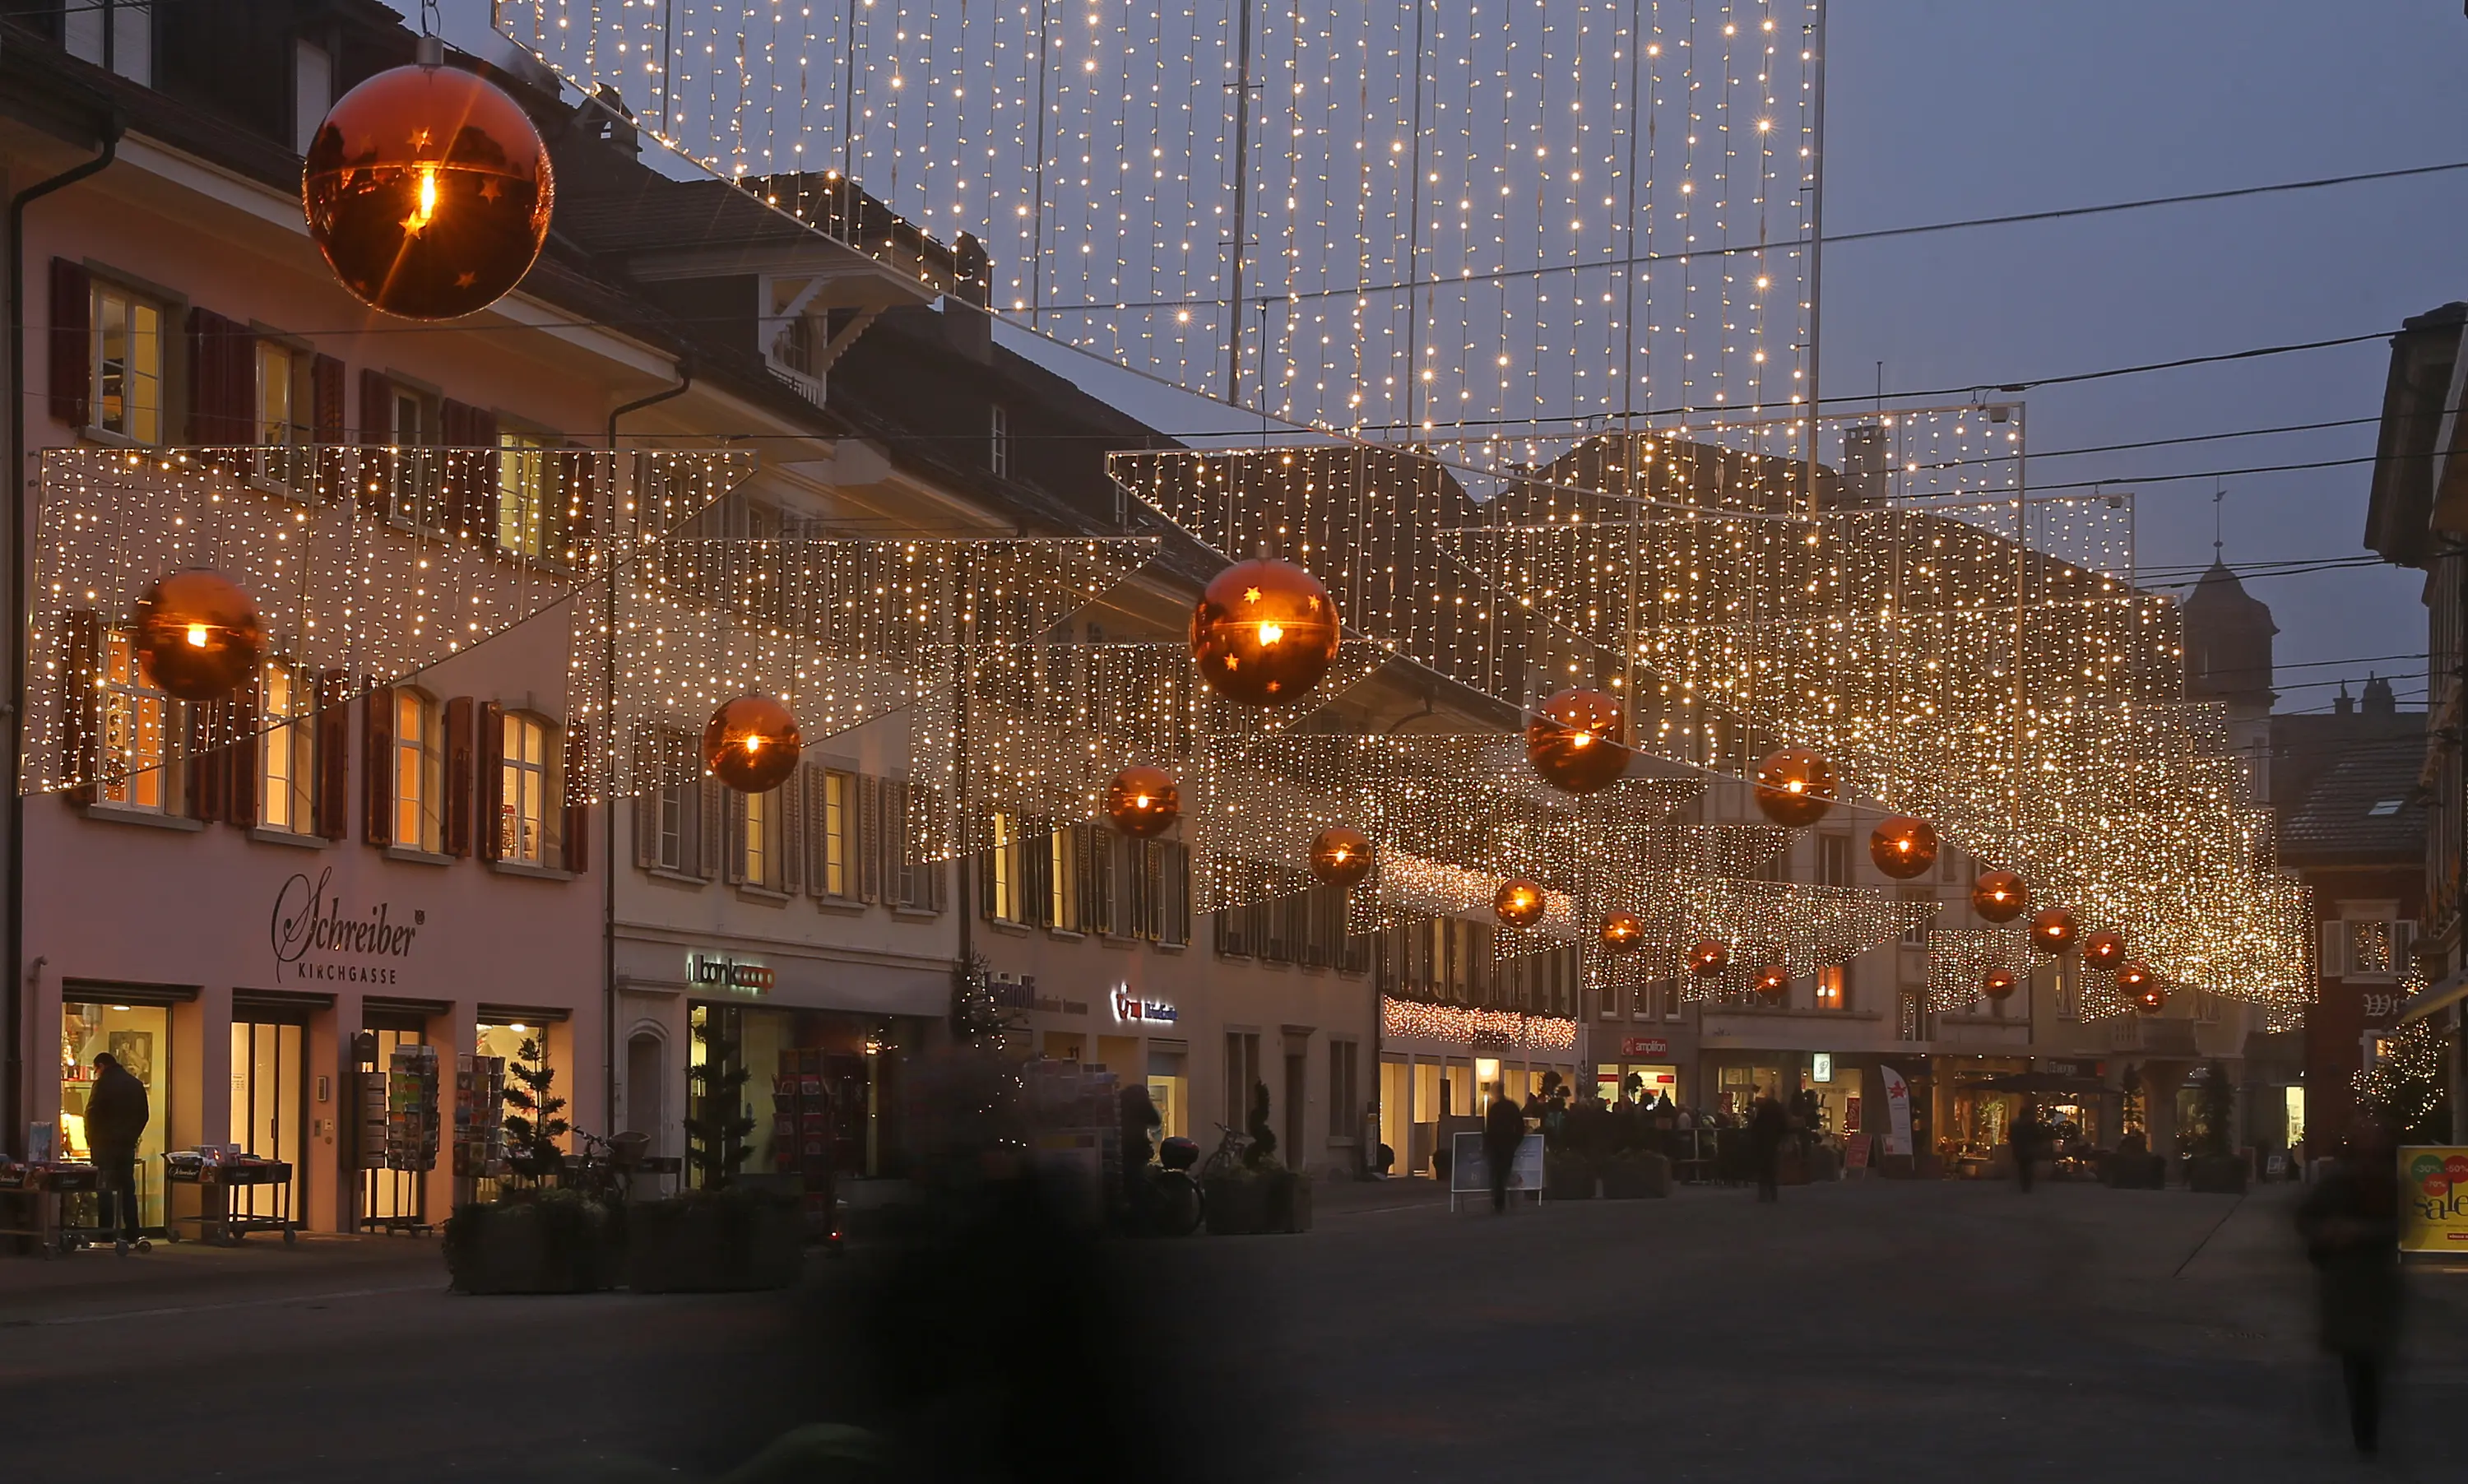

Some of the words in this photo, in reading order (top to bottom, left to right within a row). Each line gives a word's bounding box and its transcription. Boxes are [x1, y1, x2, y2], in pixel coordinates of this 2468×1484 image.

[271, 866, 415, 983] Schreiber
[299, 962, 396, 985] KIRCHGASSE
[1635, 1040, 1666, 1054] amplifon
[2413, 1179, 2468, 1220] sale
